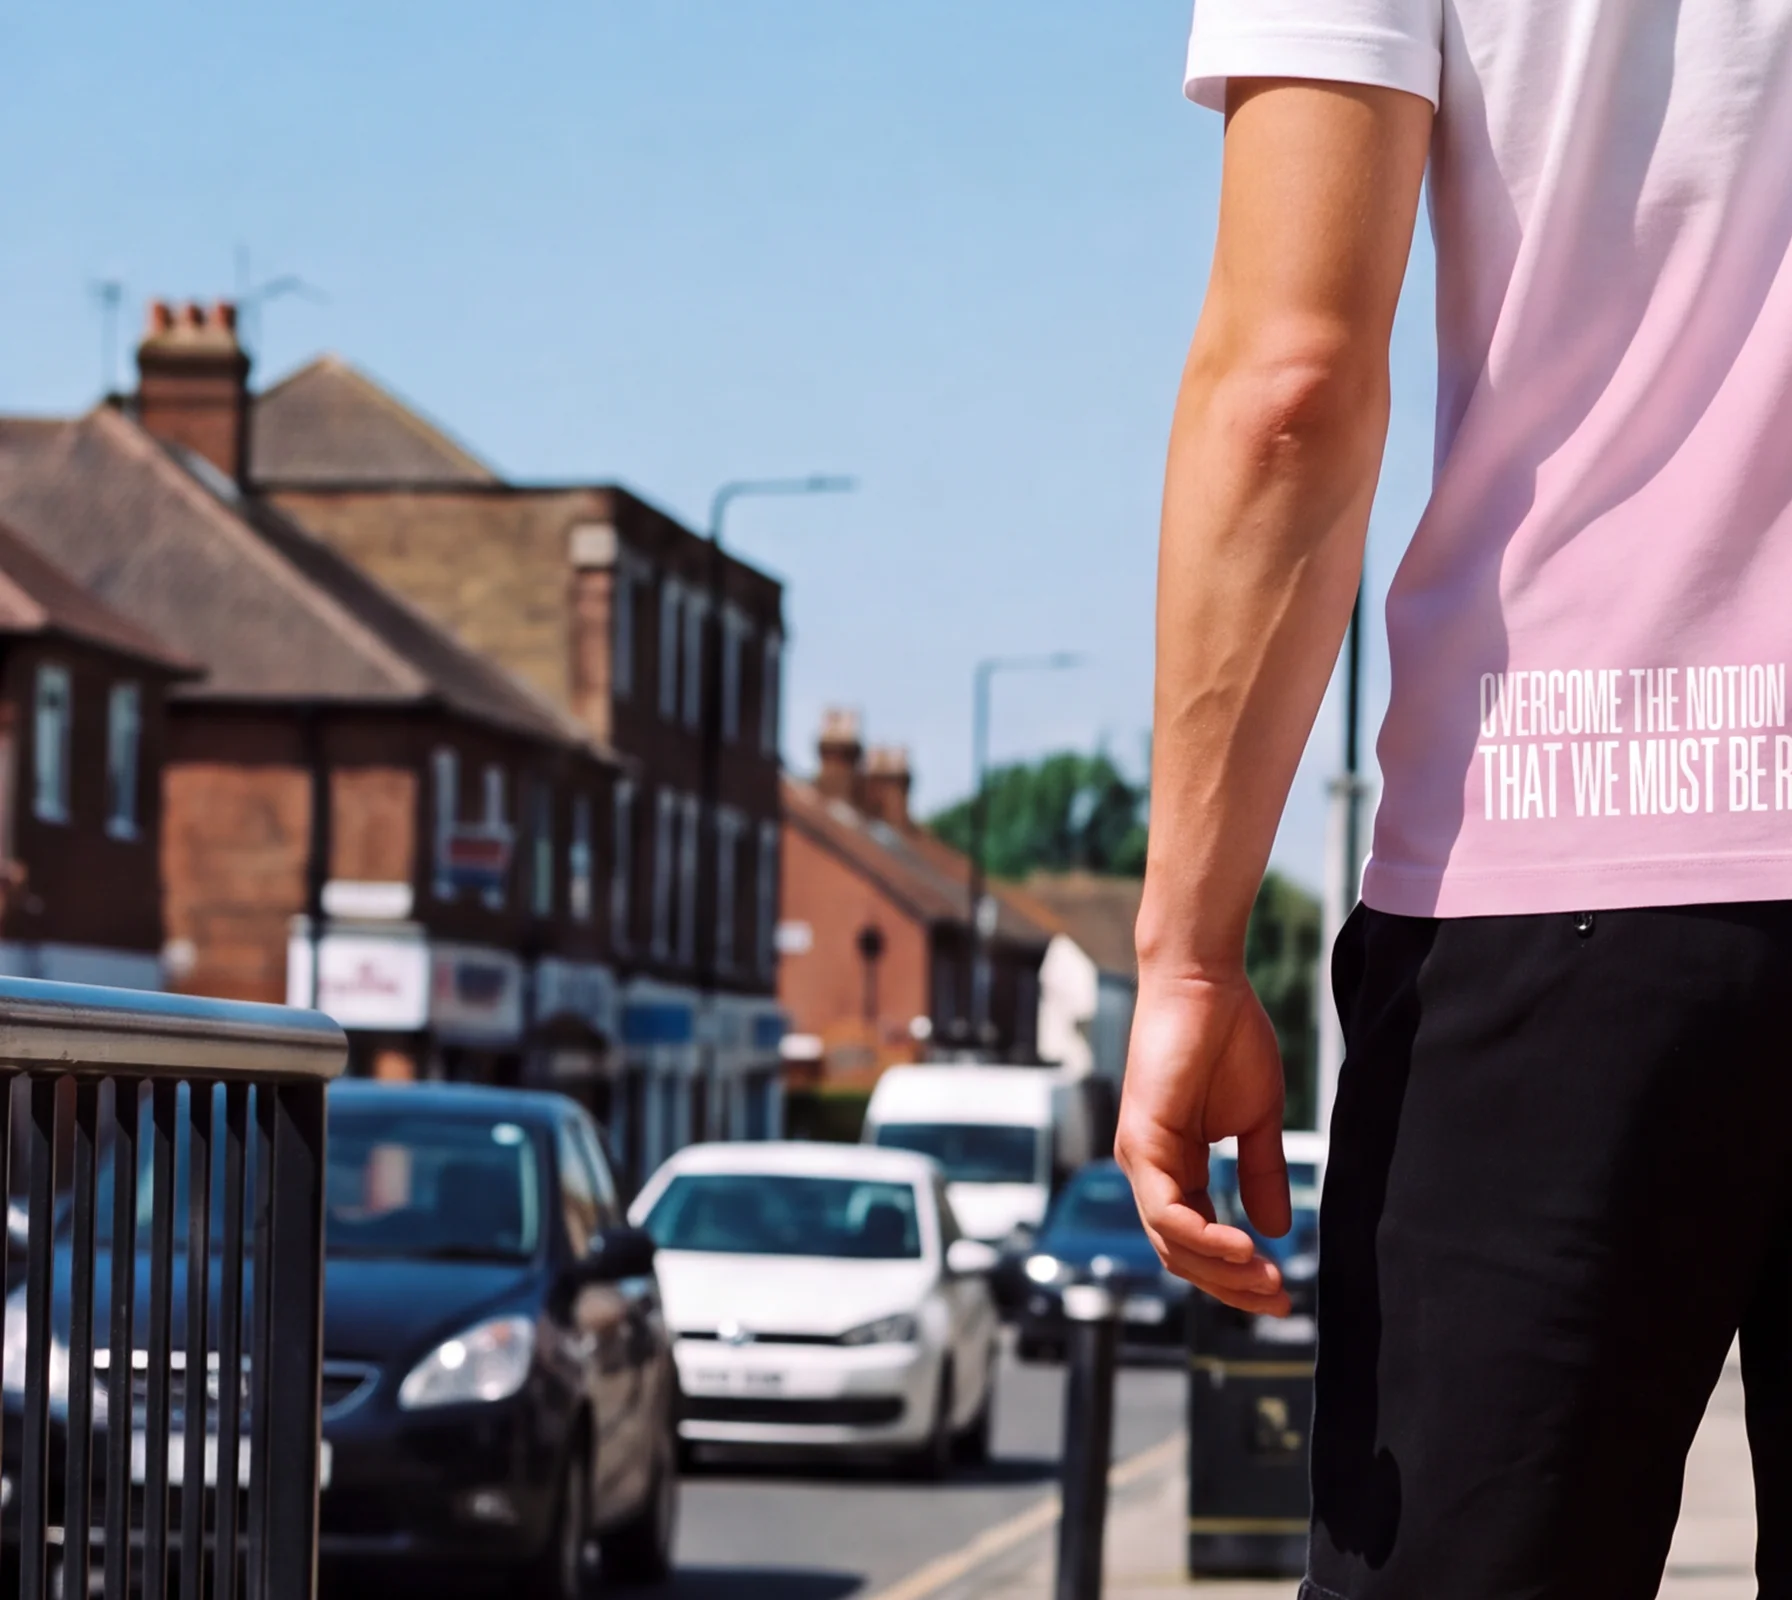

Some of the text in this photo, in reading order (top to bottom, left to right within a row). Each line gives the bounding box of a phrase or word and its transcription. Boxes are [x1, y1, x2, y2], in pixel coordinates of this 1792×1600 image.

[1479, 663, 1786, 738] OVERCOME THE NOTION
[1478, 742, 1563, 821] THAT
[1570, 740, 1621, 817] WE
[1629, 737, 1720, 816] MUST
[1728, 735, 1769, 812] BE
